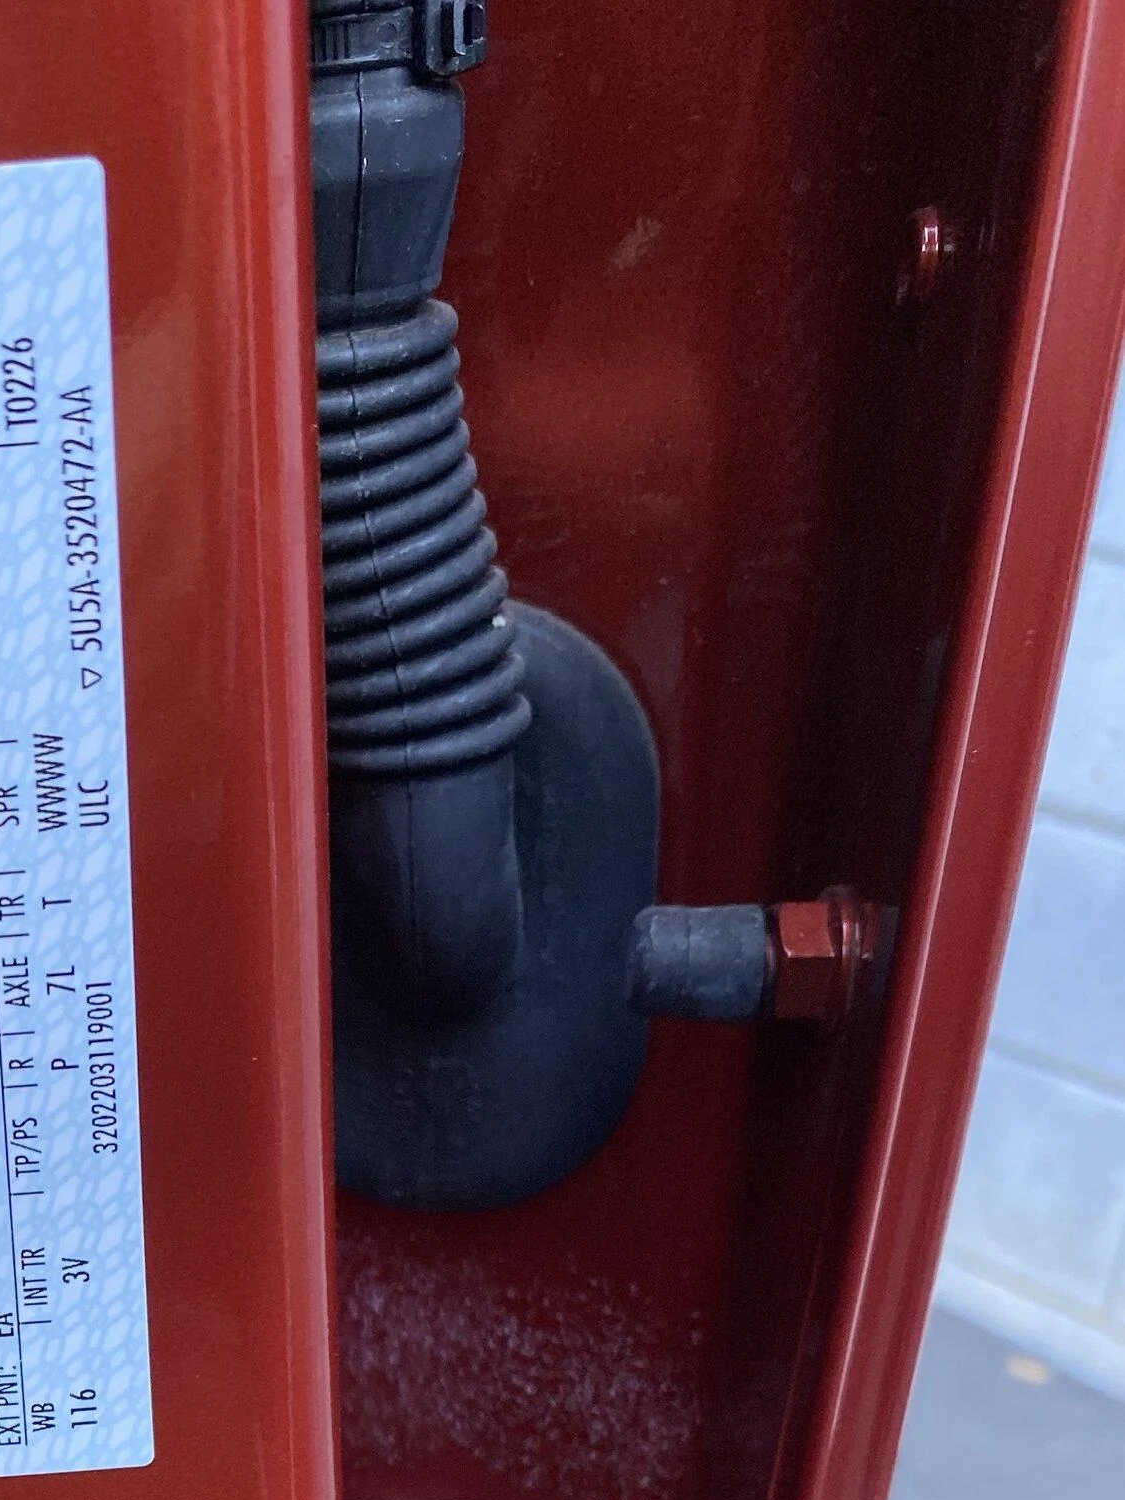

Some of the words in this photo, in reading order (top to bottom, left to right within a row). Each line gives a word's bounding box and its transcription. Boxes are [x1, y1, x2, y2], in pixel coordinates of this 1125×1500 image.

[0, 336, 38, 430] T0226
[59, 385, 103, 652] 5U5A-3520472-AA
[32, 733, 68, 833] WWWW
[77, 779, 110, 828] ULC
[1, 955, 31, 1008] AXLE
[45, 964, 77, 996] 7L
[84, 981, 119, 1155] 3202203119001
[10, 1116, 43, 1178] TP/PS
[20, 1246, 47, 1271] TR
[61, 1257, 91, 1284] 3V
[21, 1275, 49, 1307] INT
[31, 1402, 57, 1433] WB
[69, 1388, 99, 1430] 116
